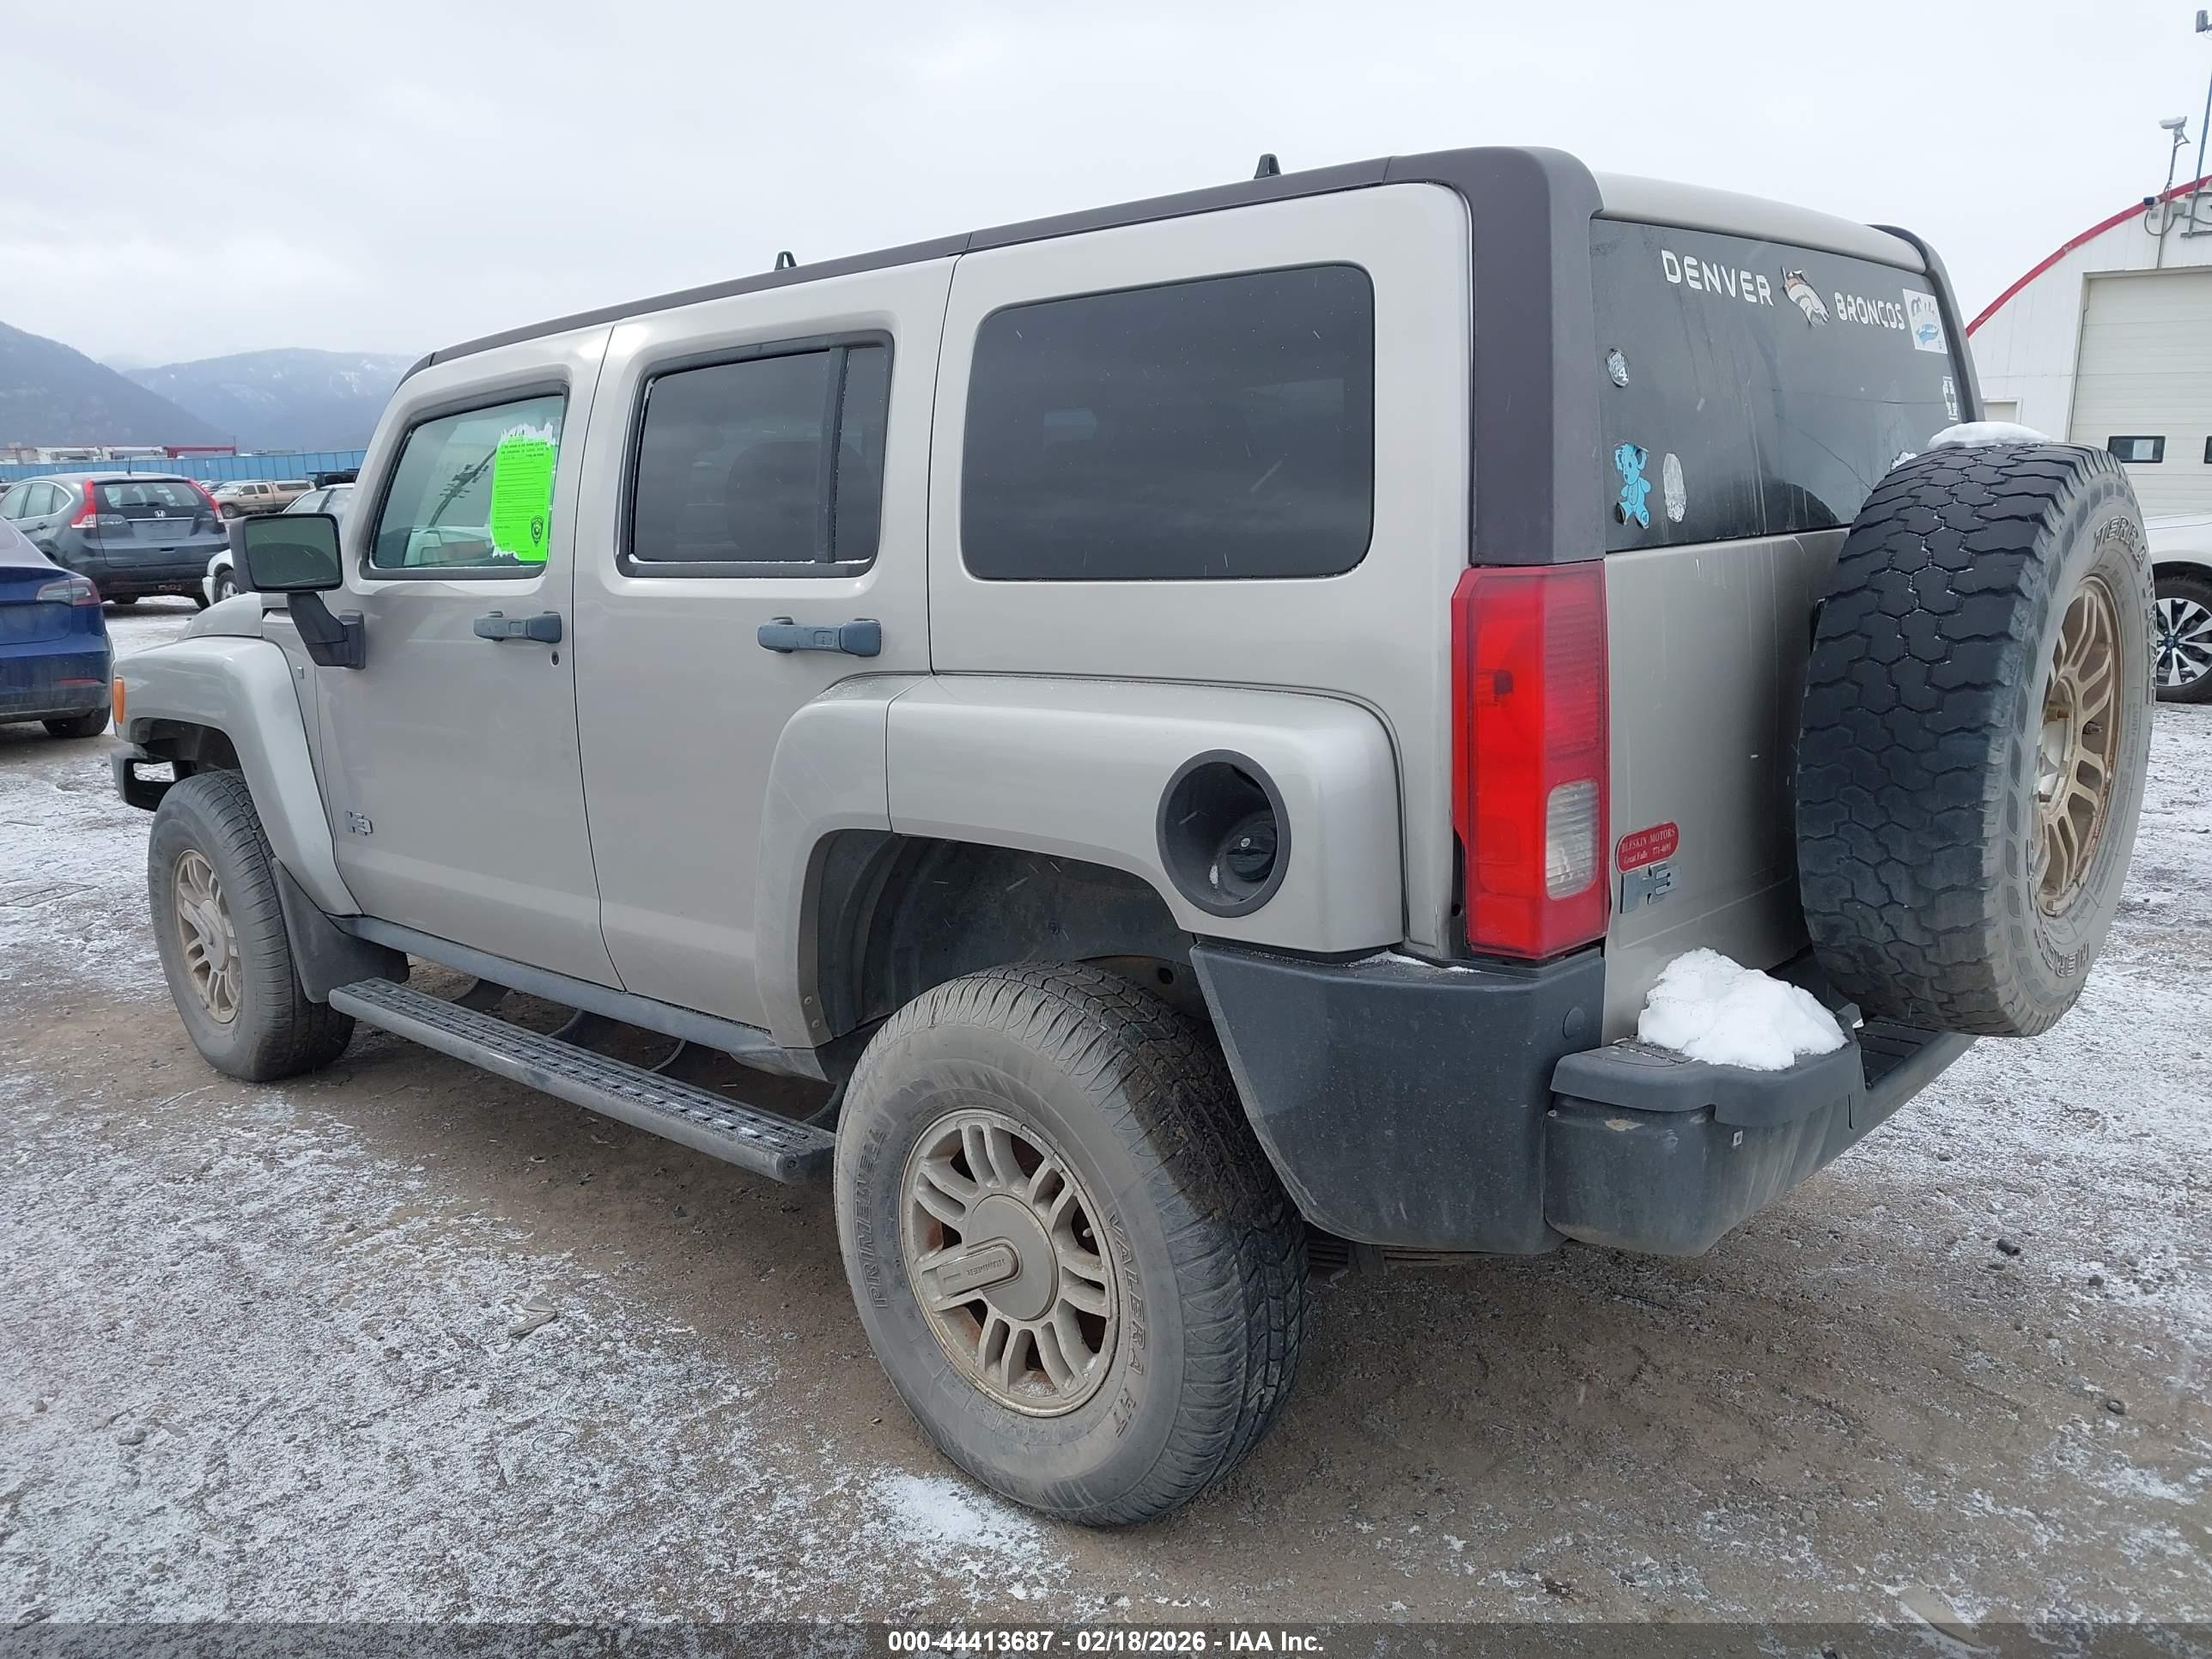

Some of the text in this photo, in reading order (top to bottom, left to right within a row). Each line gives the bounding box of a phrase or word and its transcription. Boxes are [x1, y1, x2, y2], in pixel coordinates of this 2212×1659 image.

[1661, 248, 1774, 307] DENVER
[1833, 291, 1905, 331] BRONCOS
[2094, 514, 2147, 573] TERRA
[1650, 826, 1676, 842] MOTORS
[1620, 863, 1681, 915] H3
[855, 1127, 888, 1309] PRIMEWELL
[967, 1258, 1005, 1276] HUMMER
[1108, 1212, 1146, 1376] VALERA
